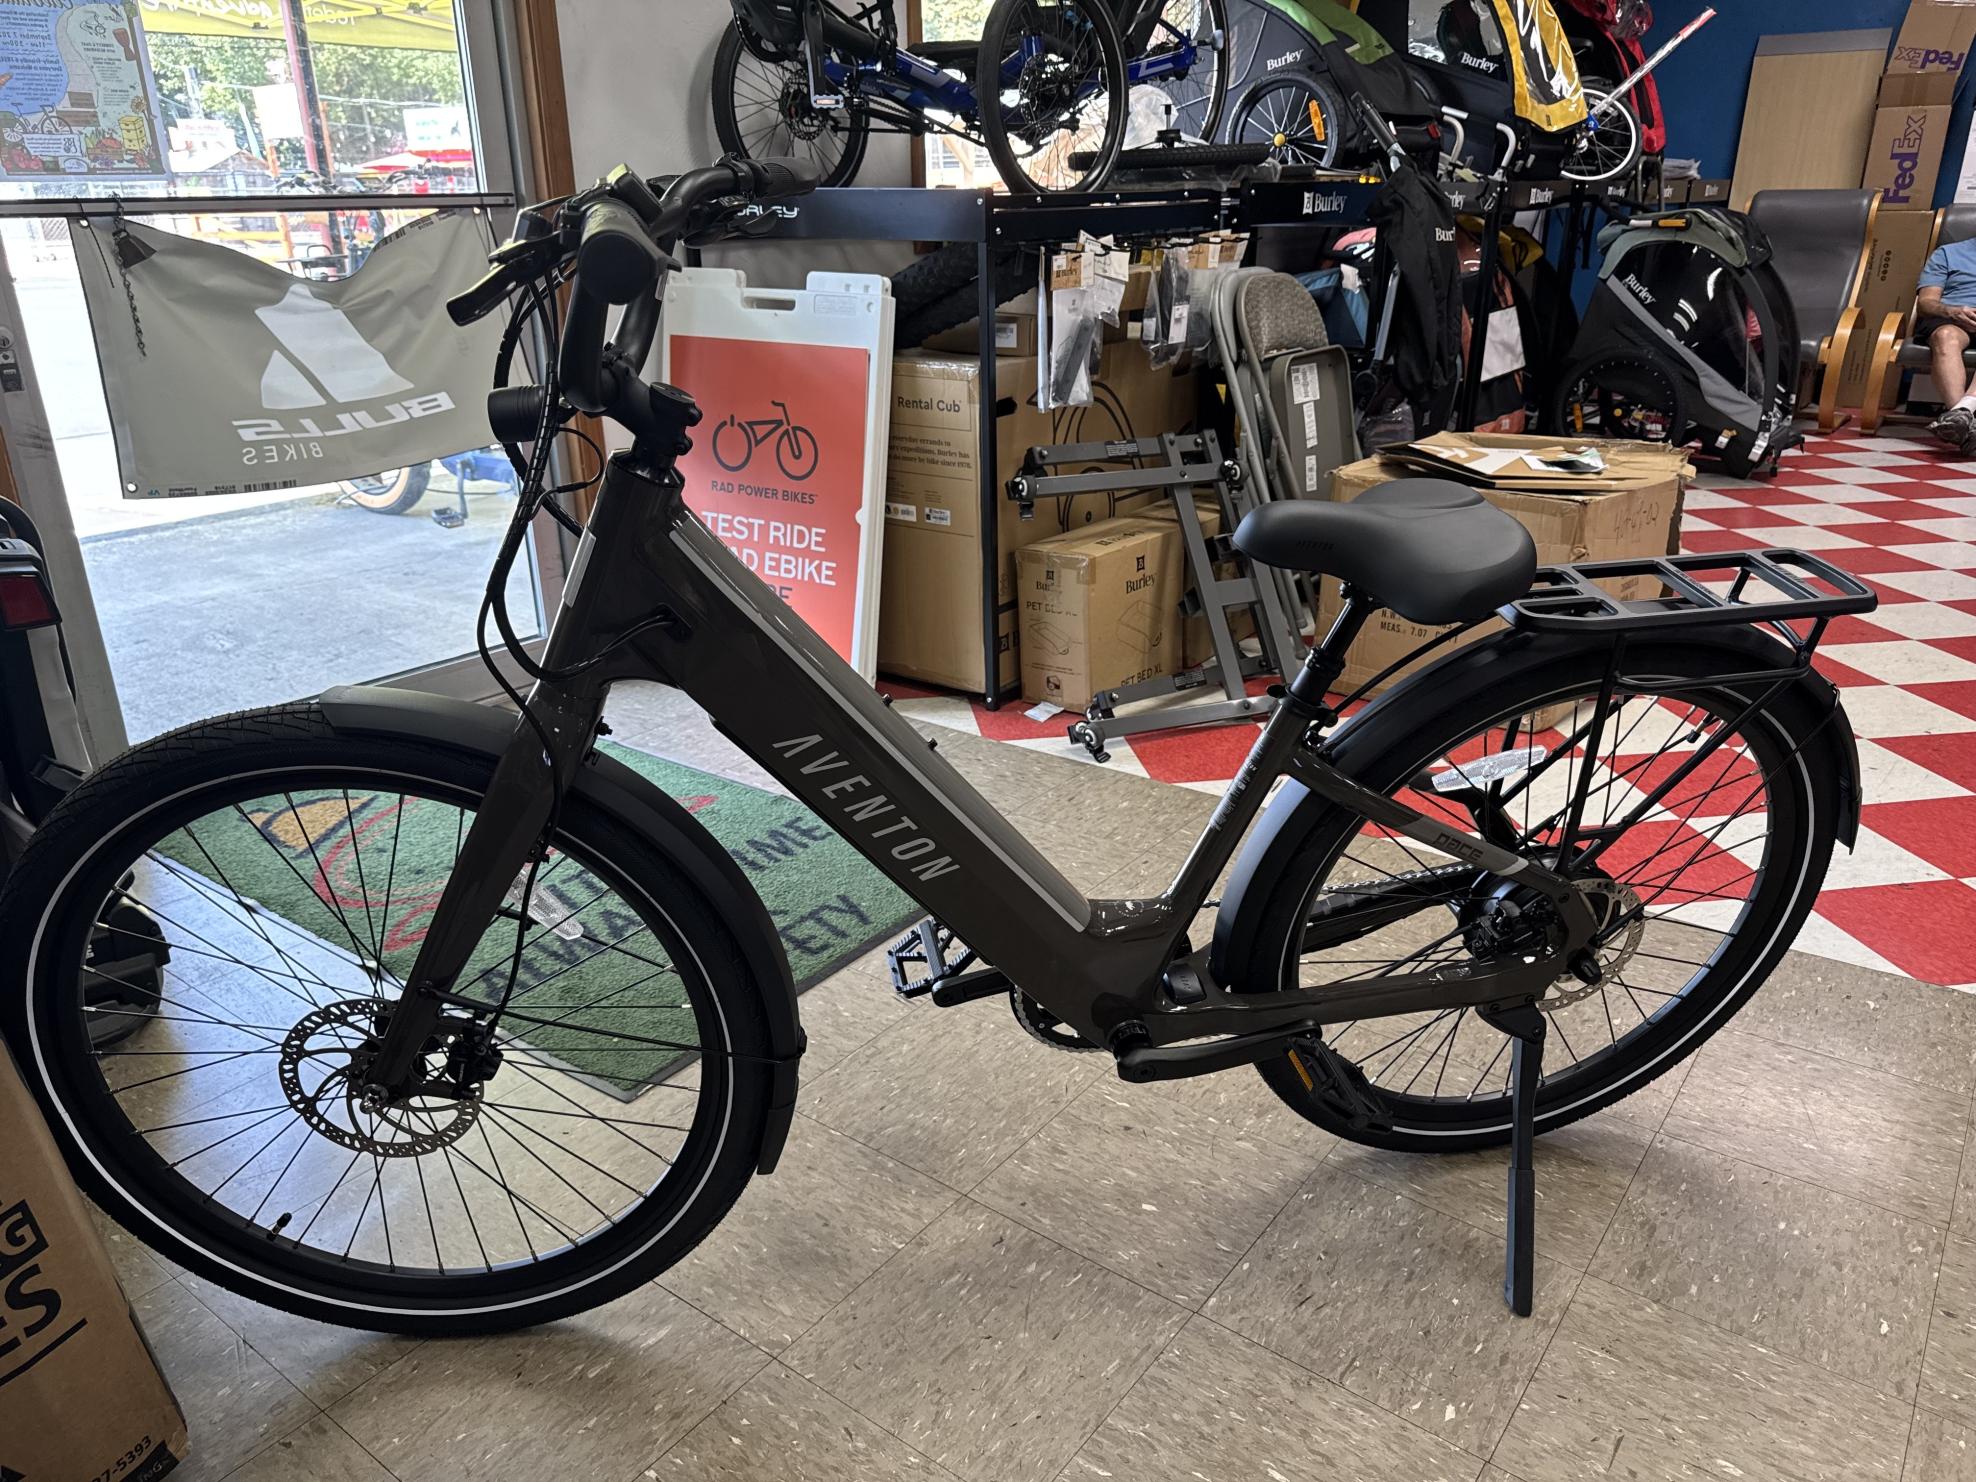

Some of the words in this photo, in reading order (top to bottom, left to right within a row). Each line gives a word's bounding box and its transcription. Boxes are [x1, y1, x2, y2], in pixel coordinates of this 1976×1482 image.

[1266, 49, 1303, 71] Burley
[1461, 52, 1499, 74] Burley
[1894, 46, 1966, 72] FedEx
[1882, 114, 1927, 204] FedEx
[1314, 191, 1347, 214] Burley
[1624, 273, 1655, 304] Burley
[897, 396, 933, 410] Rental
[936, 400, 961, 413] Cub
[711, 480, 735, 494] RAD
[738, 484, 778, 500] POWER
[782, 490, 816, 505] BIKES
[701, 511, 765, 542] TEST
[769, 521, 826, 553] RIDE
[763, 551, 837, 586] EBIKE
[1125, 573, 1156, 594] Burley
[1026, 601, 1042, 611] PET
[1410, 627, 1428, 639] 7.07
[1121, 674, 1135, 686] PET
[1138, 668, 1153, 684] BED
[1154, 663, 1163, 674] XL
[772, 734, 961, 882] AVENTON
